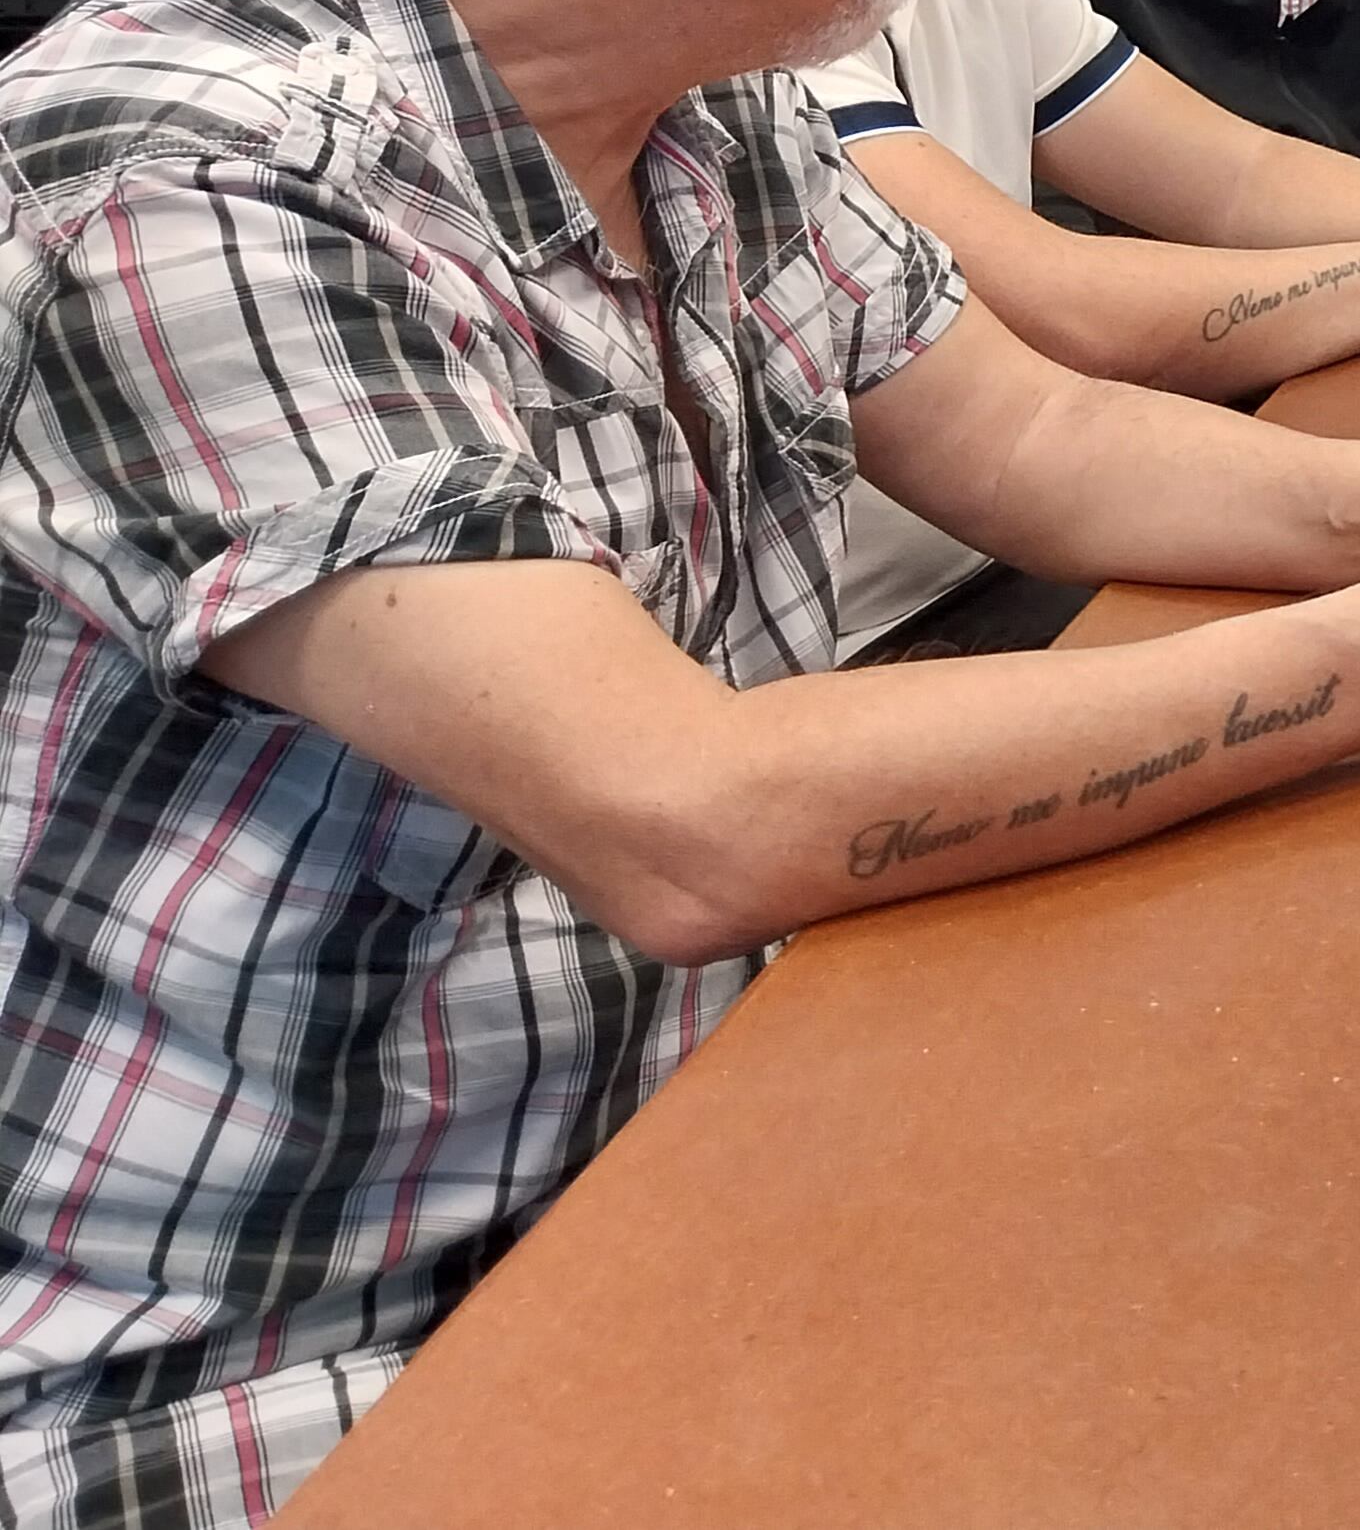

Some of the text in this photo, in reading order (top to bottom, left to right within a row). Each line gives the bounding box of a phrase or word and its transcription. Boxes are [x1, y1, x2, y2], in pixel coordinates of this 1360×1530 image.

[1202, 289, 1282, 342] Nemo
[1287, 281, 1311, 302] me
[848, 808, 993, 880] Nemo
[1006, 792, 1061, 830] me
[1076, 735, 1210, 810] impune
